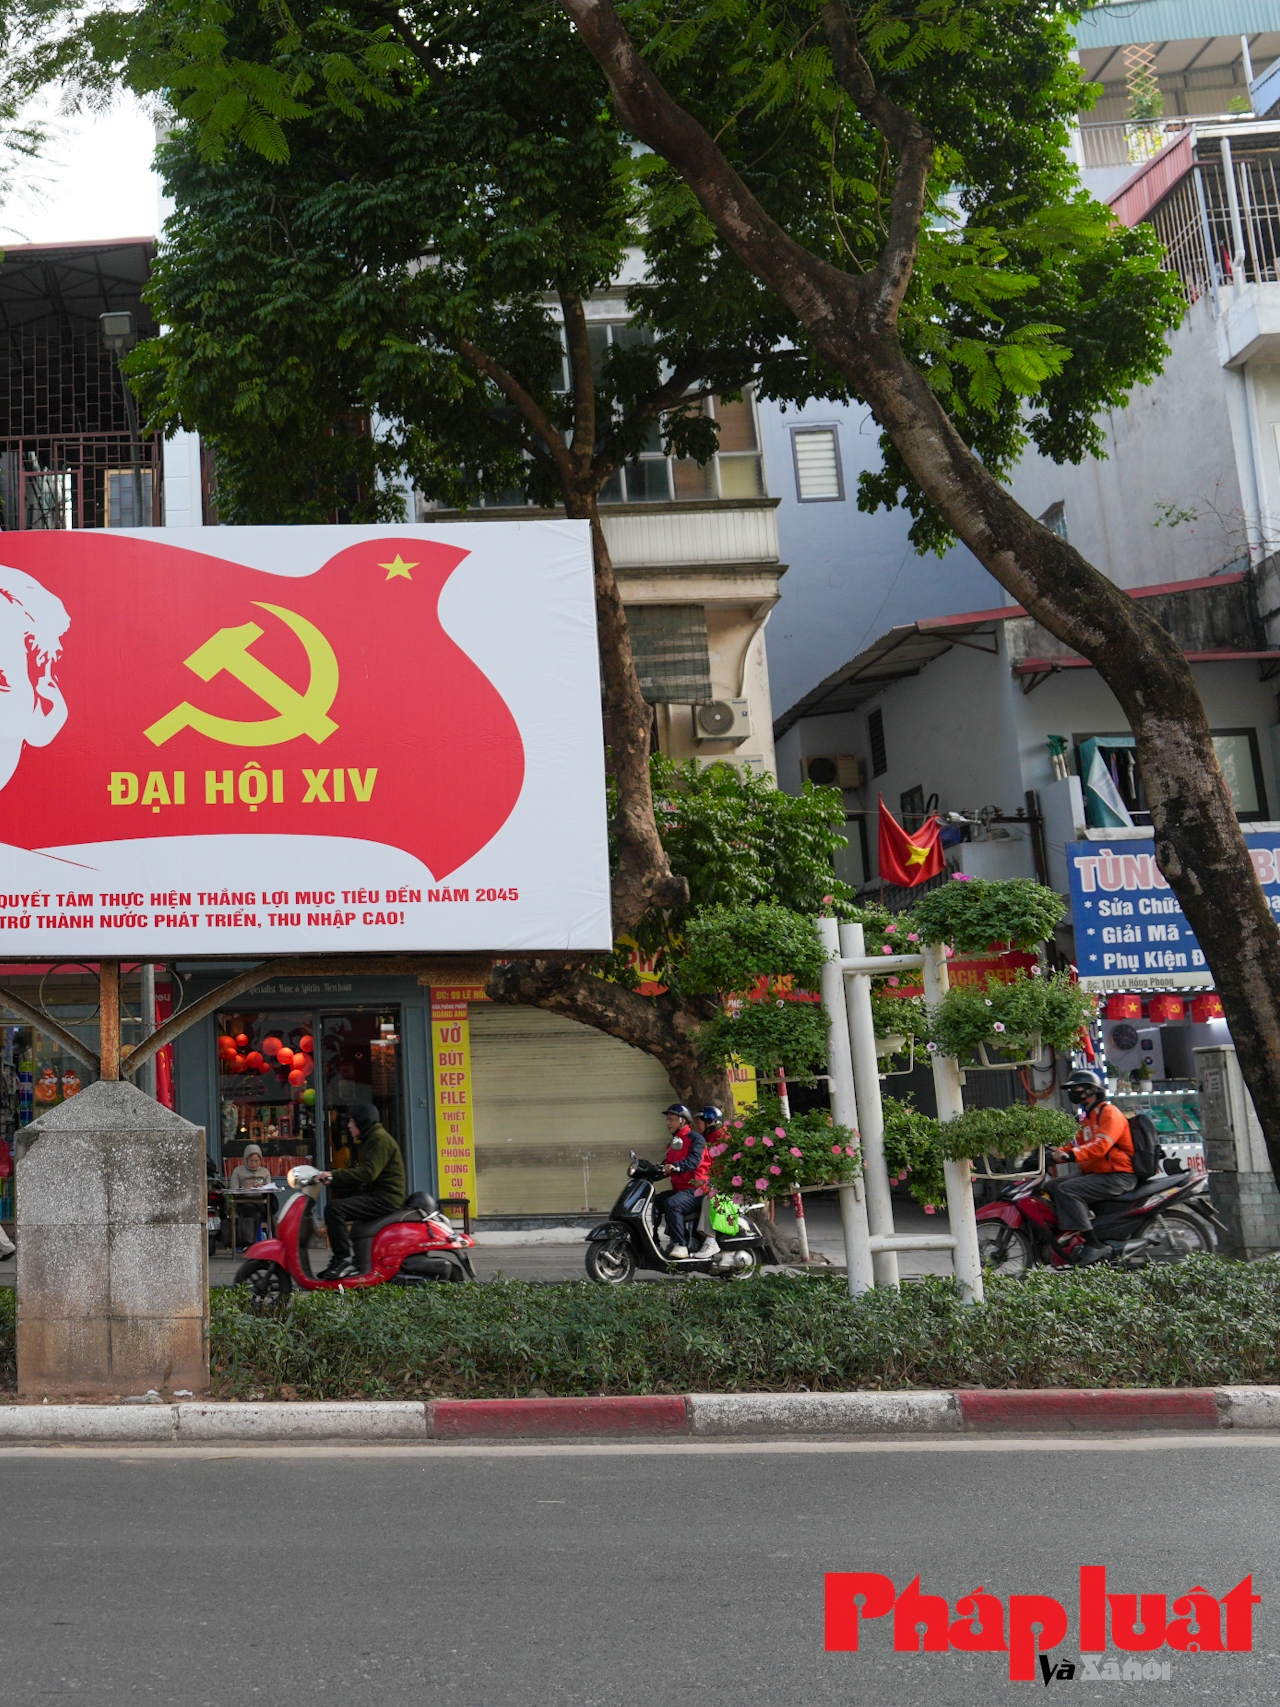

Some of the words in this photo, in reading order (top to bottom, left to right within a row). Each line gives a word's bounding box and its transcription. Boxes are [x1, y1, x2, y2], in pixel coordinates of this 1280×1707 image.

[107, 771, 185, 813] ĐẠI
[205, 761, 284, 812] HỘI
[301, 768, 378, 803] XIV
[56, 891, 94, 907] TÂM
[100, 892, 144, 909] THỰC
[151, 890, 192, 909] HIỆN
[197, 887, 256, 906] THẮNG
[262, 890, 289, 908] LỢI
[296, 891, 336, 908] MỤC
[341, 888, 380, 904] TIÊU
[385, 885, 421, 904] ĐẾN
[428, 886, 469, 902] NĂM
[476, 888, 519, 902] 2045
[1098, 898, 1133, 916] Sửa
[36, 911, 94, 928] THÀNH
[100, 911, 148, 928] NƯỚC
[154, 911, 199, 928] PHÁT
[205, 908, 262, 928] TRIỂN,
[268, 913, 301, 926] THU
[307, 910, 357, 929] NHẬP
[362, 911, 405, 925] CAO!
[1102, 922, 1141, 944] Giải
[1148, 924, 1180, 942] Mã
[1103, 952, 1139, 972] Phụ
[1144, 949, 1188, 971] Kiện
[1102, 978, 1115, 988] 101
[1128, 976, 1148, 988] Hồng
[1150, 976, 1174, 988] Phong
[451, 991, 460, 999] 99
[463, 989, 472, 999] LÊ
[432, 1008, 453, 1018] HOÀNG
[454, 1009, 467, 1017] ANH
[440, 1022, 461, 1043] VỞ
[439, 1050, 464, 1066] BÚT
[440, 1072, 465, 1089] KẸP
[441, 1091, 466, 1104] FILE
[442, 1110, 466, 1121] THIẾT
[450, 1124, 459, 1135] BỊ
[446, 1135, 464, 1145] VĂN
[441, 1146, 471, 1158] PHÒNG
[444, 1164, 469, 1175] DỤNG
[451, 1178, 463, 1188] CỤ
